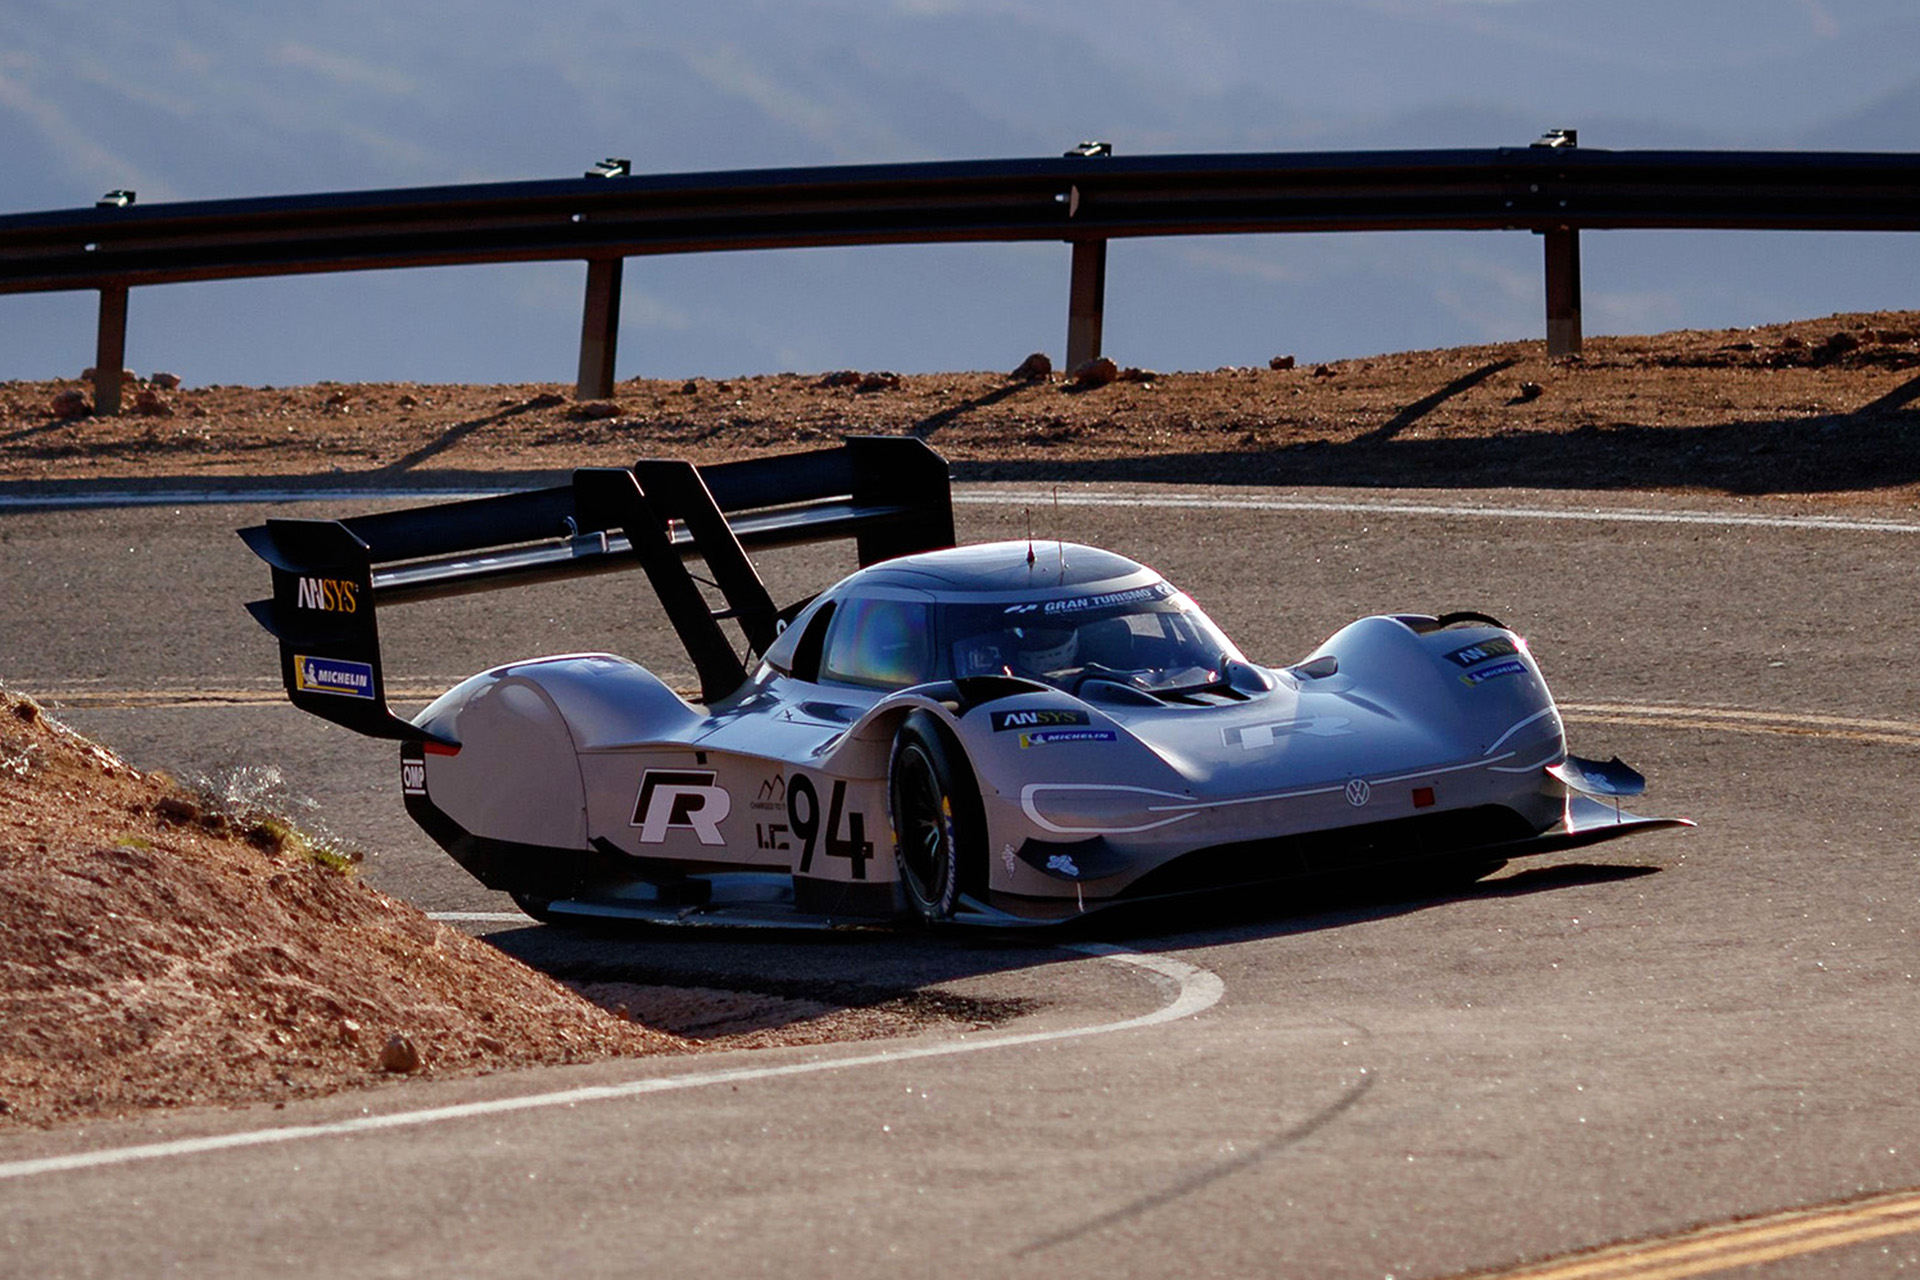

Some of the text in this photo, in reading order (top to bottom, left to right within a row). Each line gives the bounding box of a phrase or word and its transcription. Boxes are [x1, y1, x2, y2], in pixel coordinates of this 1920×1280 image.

[298, 577, 357, 613] ANSYS
[1044, 598, 1088, 613] GRAN
[1091, 588, 1151, 606] TURISMO
[318, 669, 367, 687] MICHELIN
[1003, 711, 1077, 726] ANSYS
[1047, 733, 1109, 741] MICHELIN
[403, 765, 425, 788] OMP
[630, 769, 731, 845] R
[787, 773, 874, 879] 94
